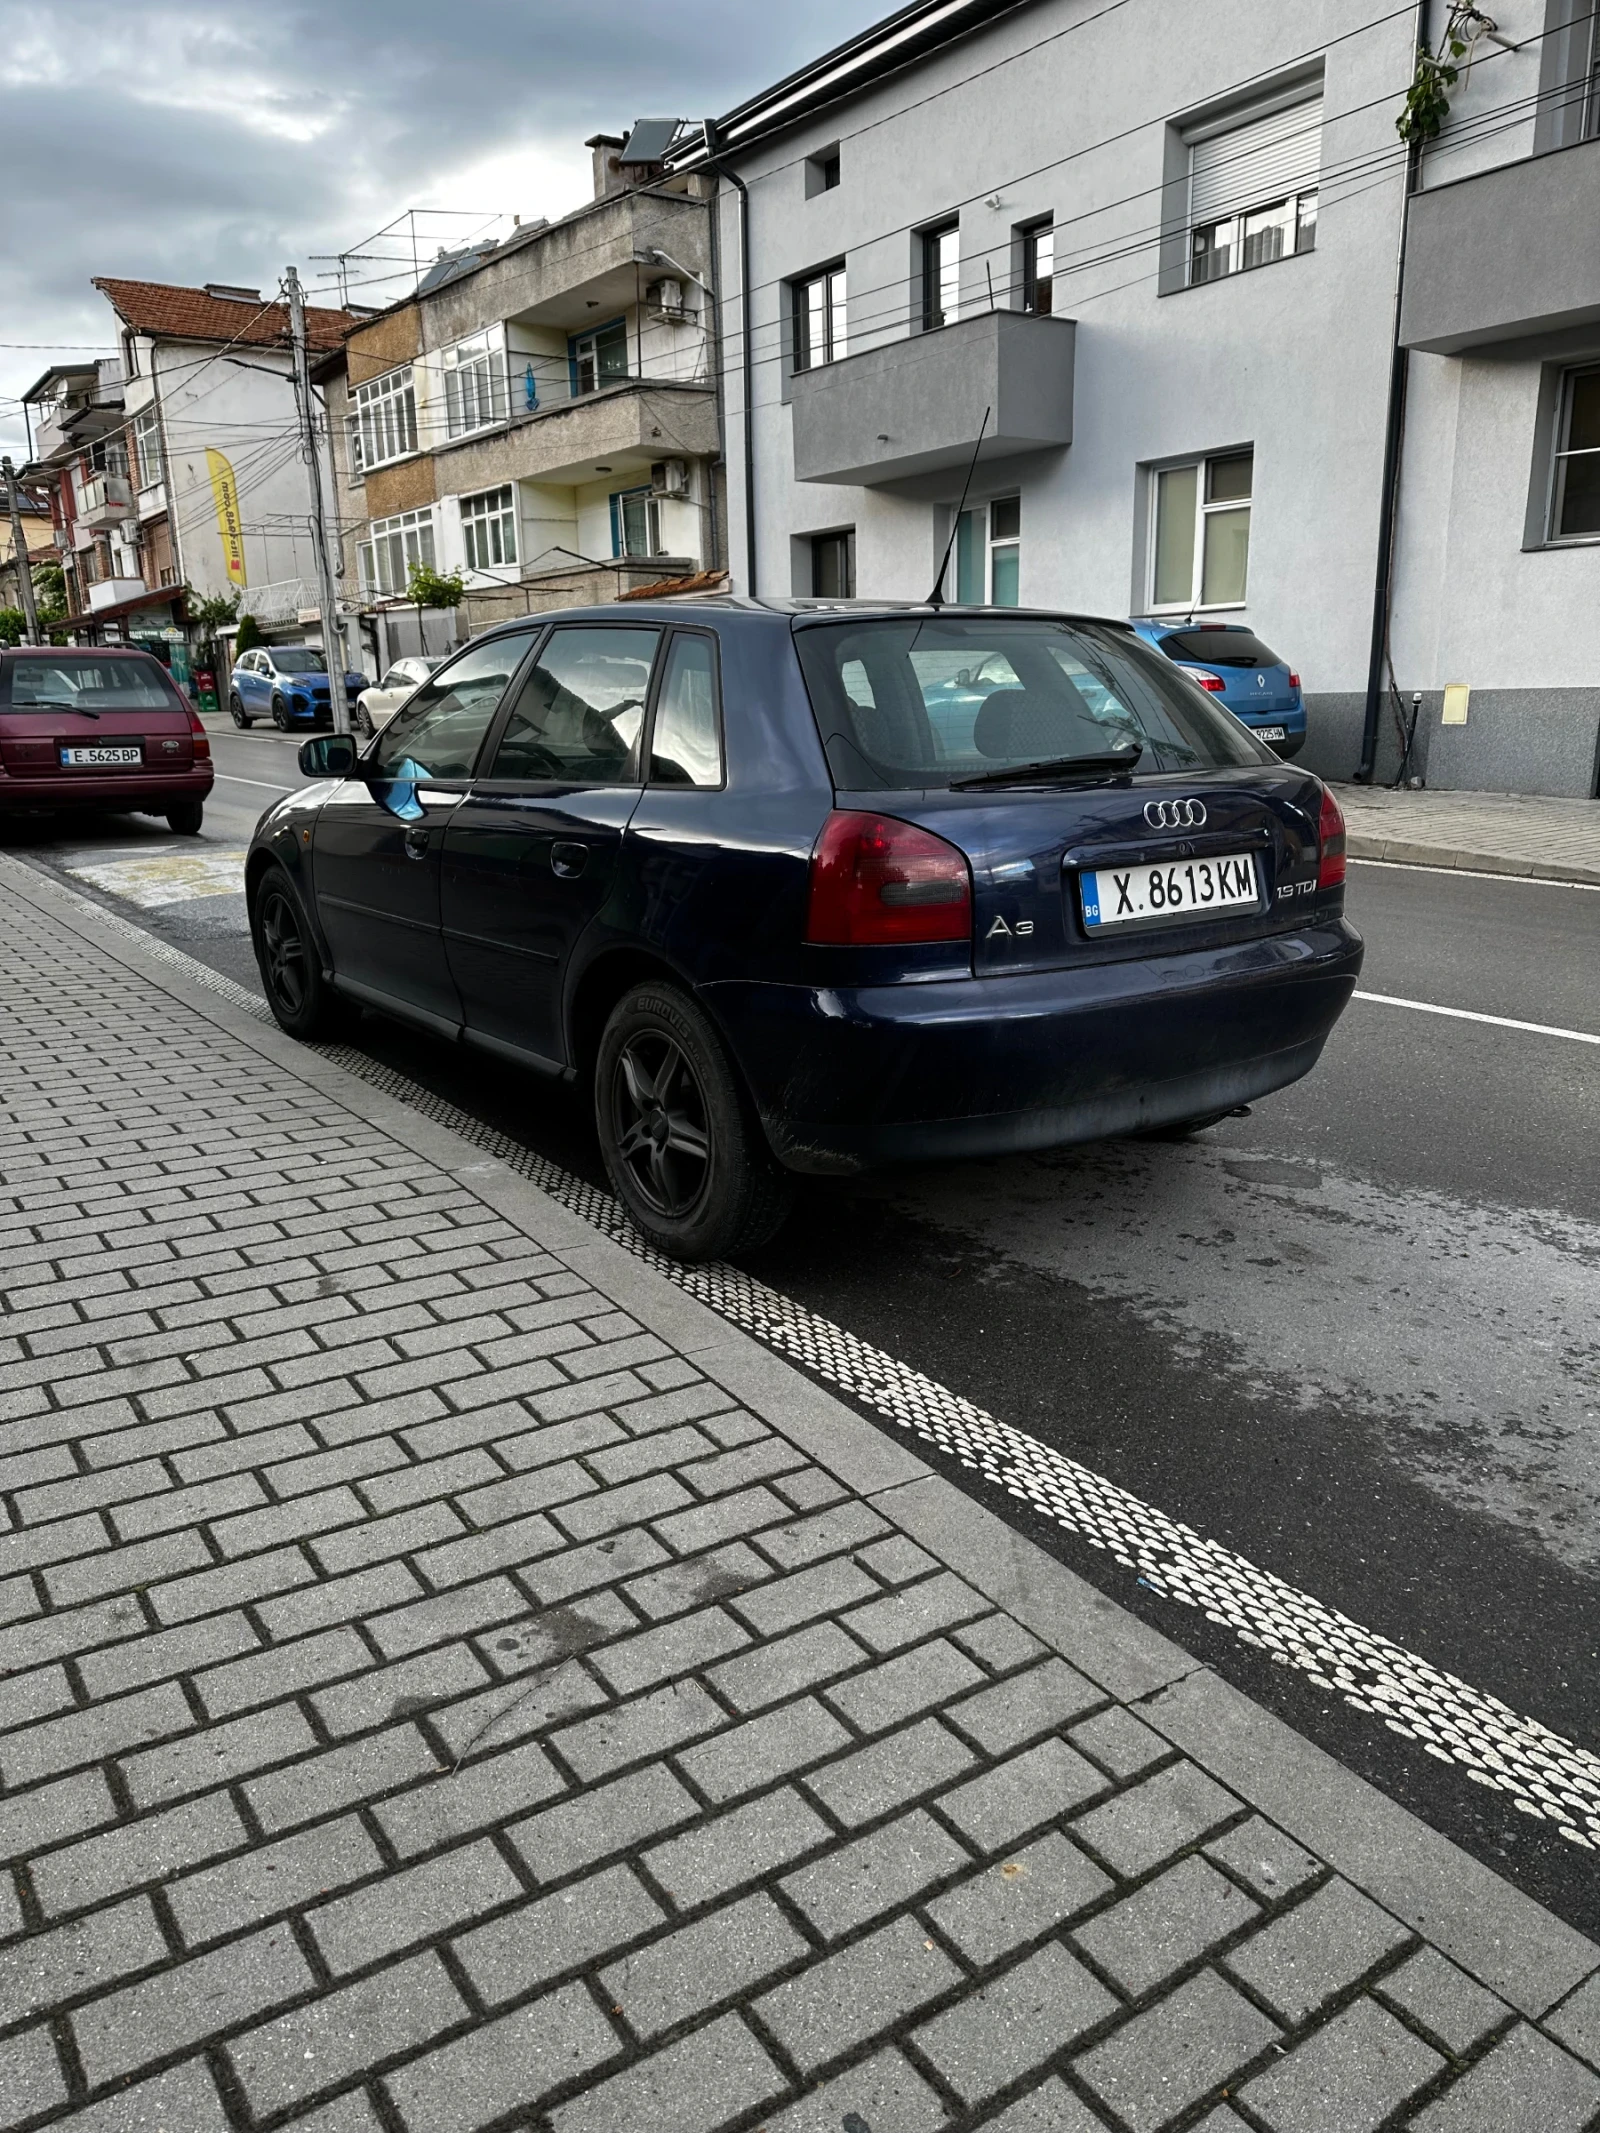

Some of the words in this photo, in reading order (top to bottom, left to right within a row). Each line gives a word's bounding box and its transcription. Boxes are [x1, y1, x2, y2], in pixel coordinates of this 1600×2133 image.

[1295, 878, 1317, 896] TDI
[1085, 905, 1099, 918] BG
[985, 915, 1034, 939] A3
[637, 996, 691, 1038] EUROVIS
